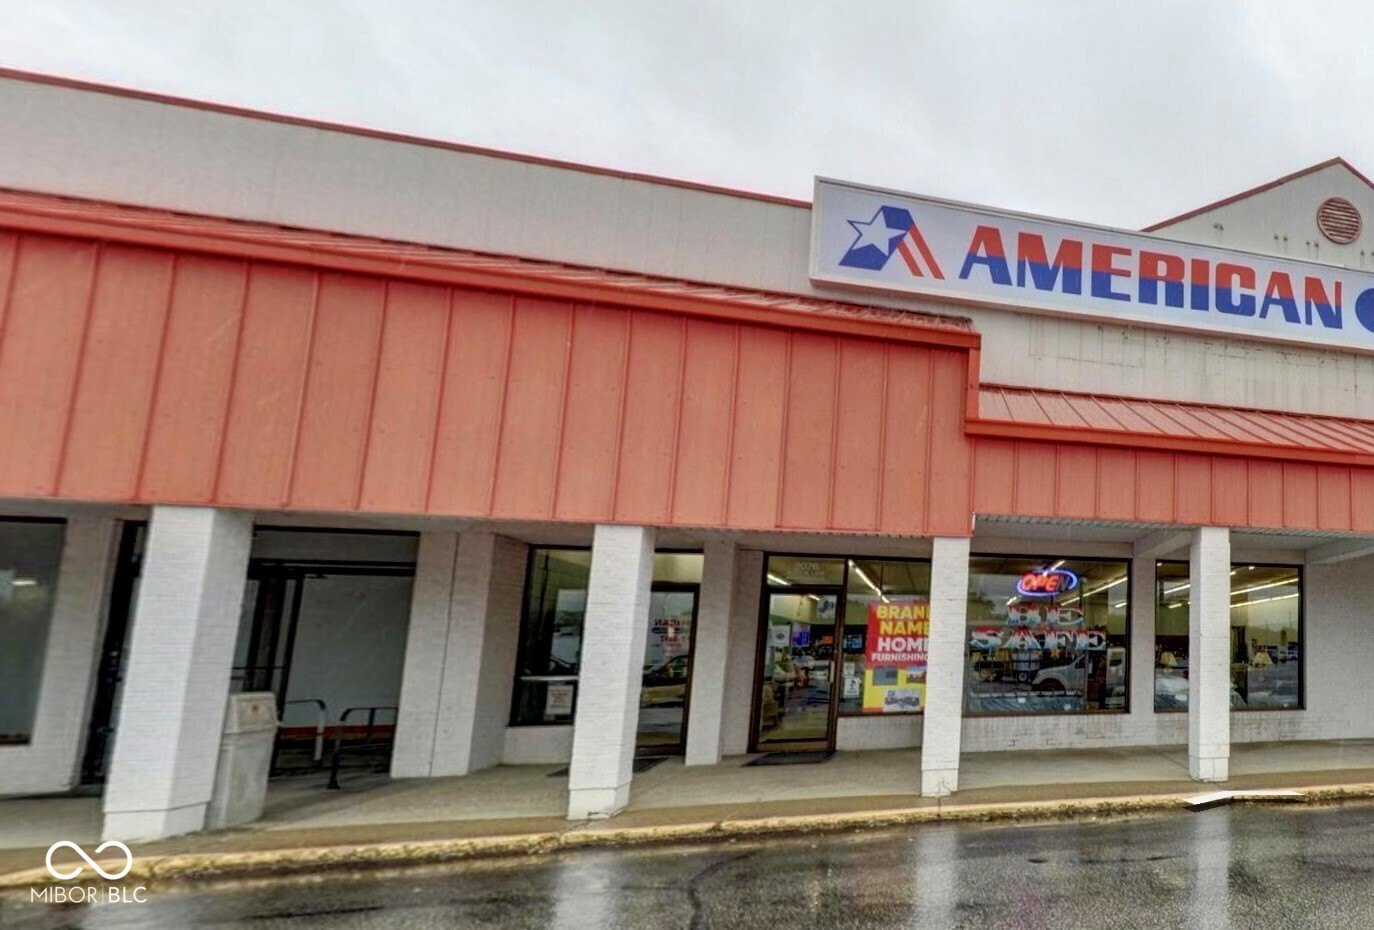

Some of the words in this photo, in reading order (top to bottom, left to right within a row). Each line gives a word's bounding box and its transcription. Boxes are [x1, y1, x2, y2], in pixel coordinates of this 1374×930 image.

[958, 224, 1343, 330] AMERICAN
[1021, 573, 1069, 592] OPEN
[1006, 603, 1084, 627] BE
[969, 626, 1107, 651] SAFE
